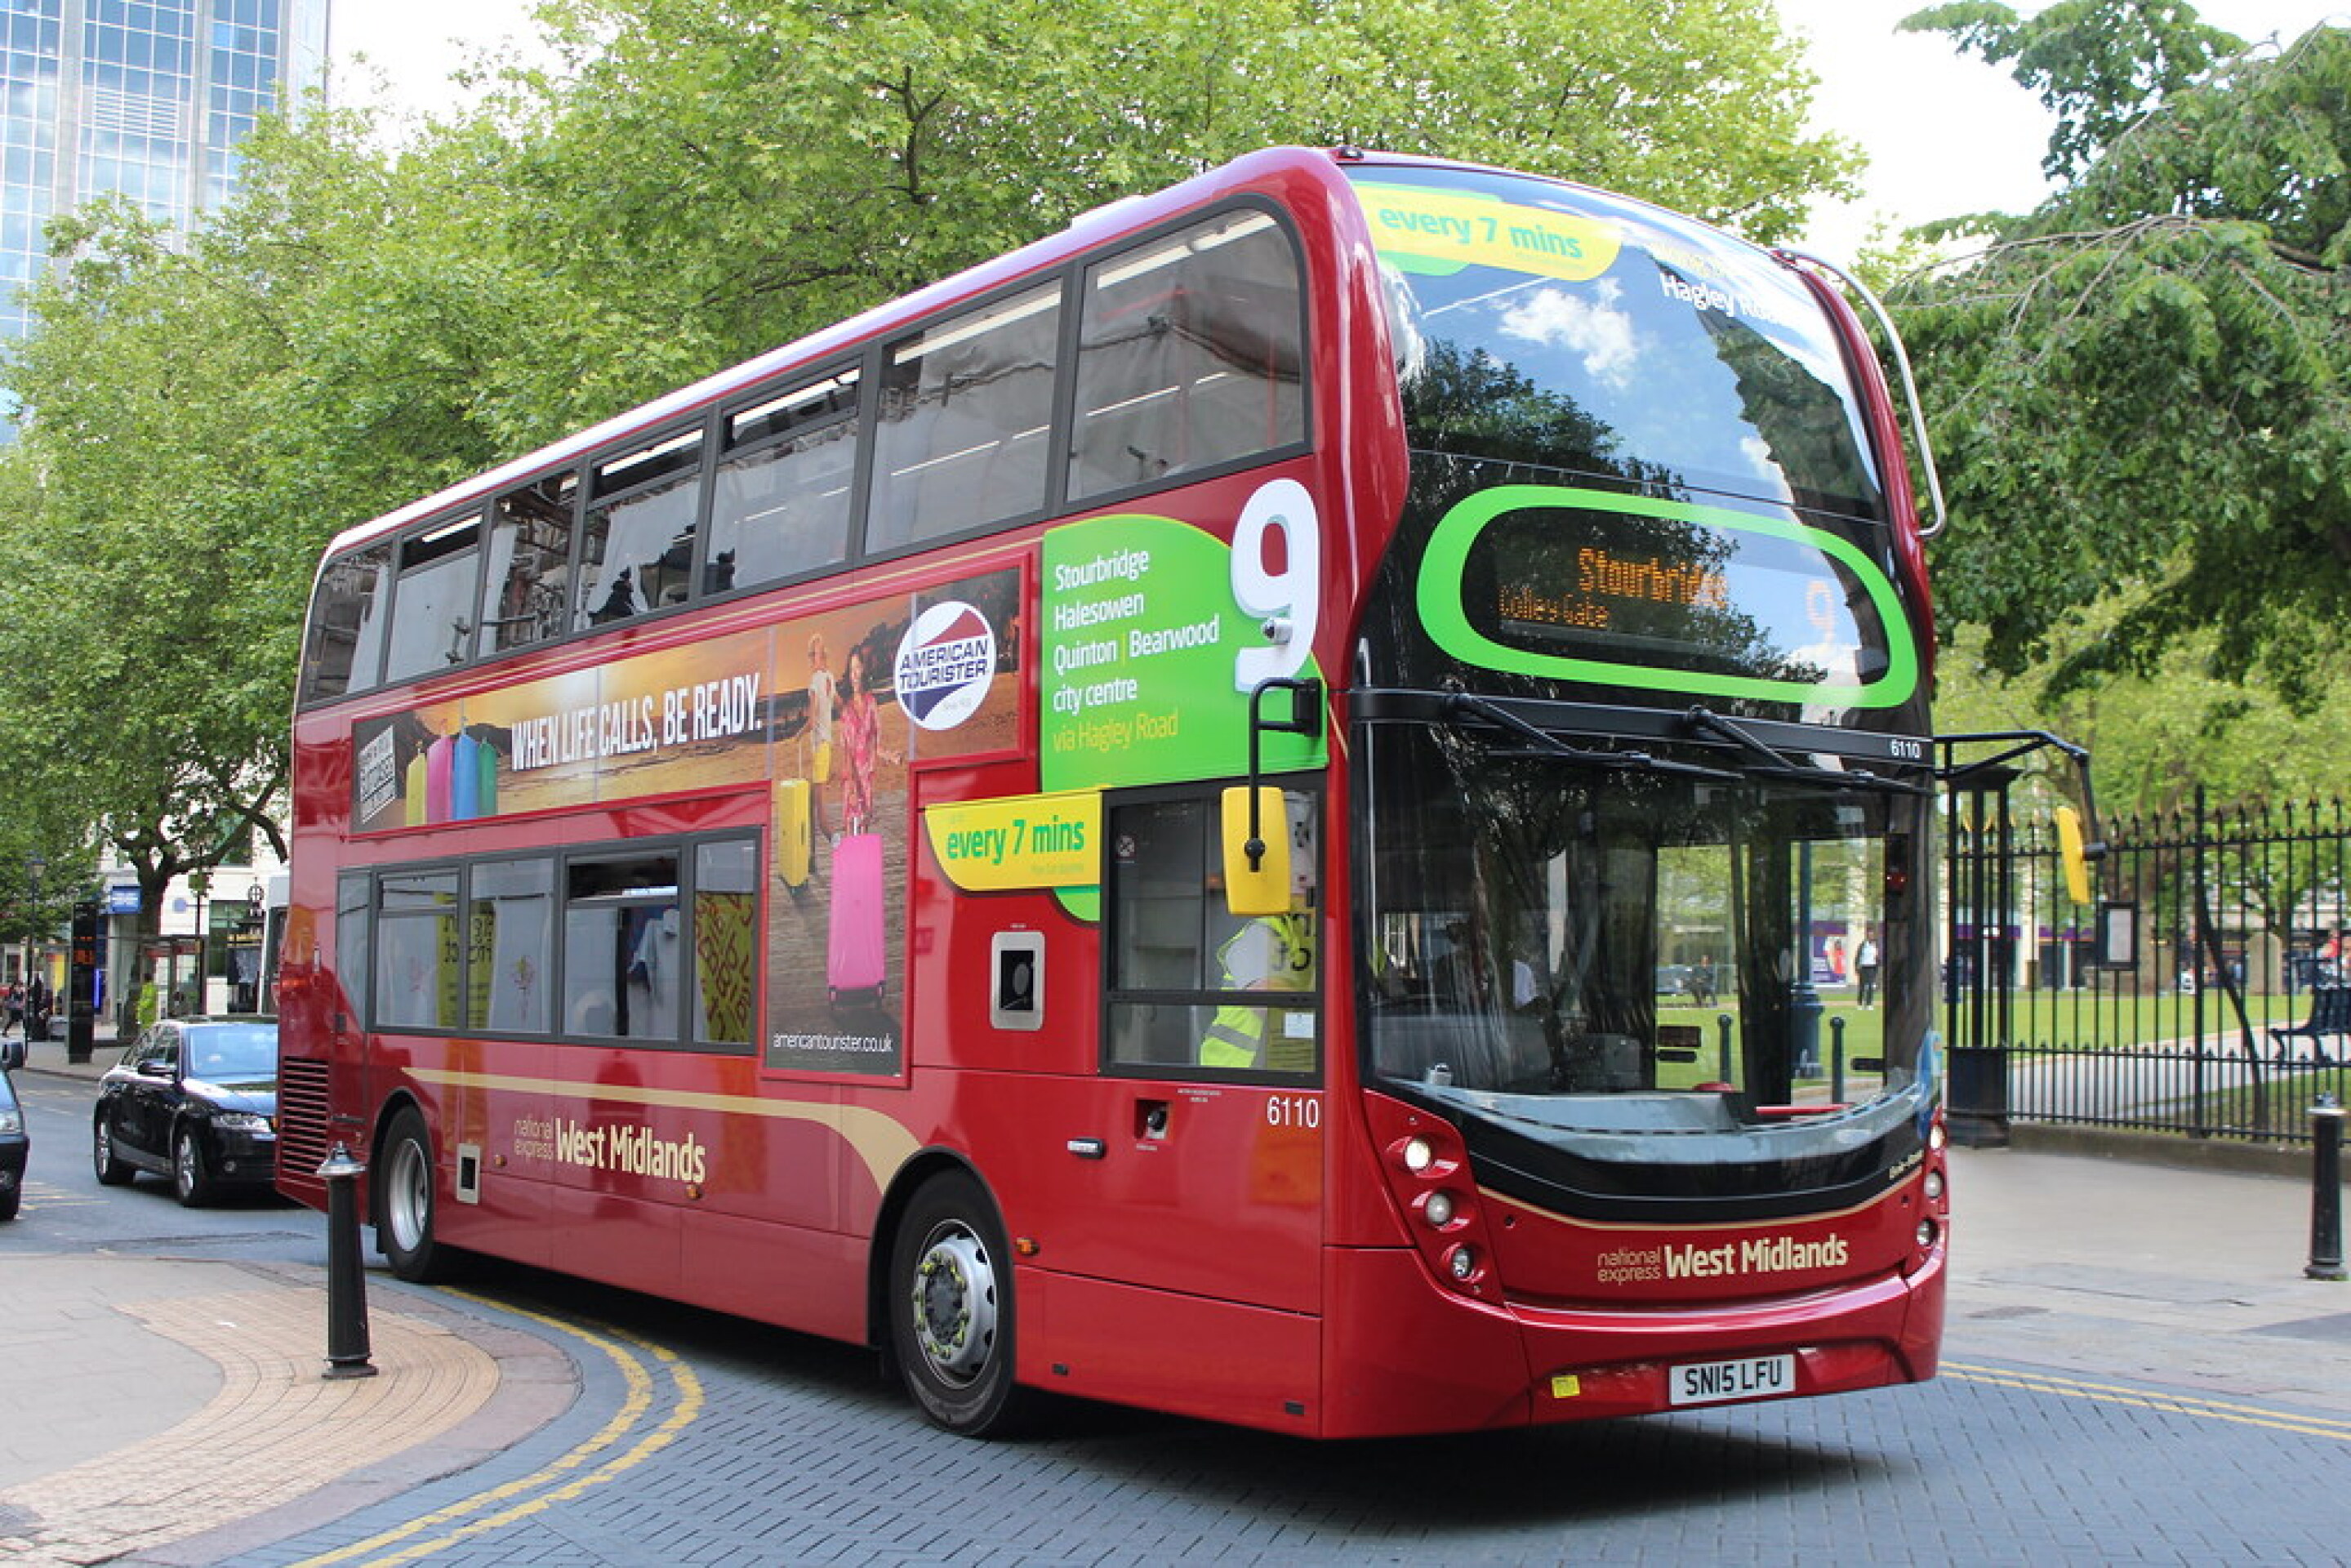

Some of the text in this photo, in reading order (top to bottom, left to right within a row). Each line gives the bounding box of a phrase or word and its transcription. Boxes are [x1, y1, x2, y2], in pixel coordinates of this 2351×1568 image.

[1378, 207, 1583, 259] every 7 mins
[1659, 272, 1734, 318] Hagley
[1055, 546, 1150, 591] Stourbridge
[1231, 477, 1320, 693] 9
[1054, 592, 1144, 632] Halesowen
[899, 637, 988, 671] AMERICAN
[1053, 612, 1221, 676] Quinton Bearwood
[899, 658, 988, 691] TOURISTER
[1053, 676, 1138, 717] city centre
[511, 672, 764, 772] WHEN LIFE CALLS, BE READY.
[1053, 706, 1179, 754] via Hagley Road
[1890, 738, 1921, 759] 6110
[947, 814, 1085, 866] every 7 mins
[514, 1114, 554, 1140] national
[1267, 1094, 1320, 1129] 6110
[514, 1138, 554, 1160] express
[554, 1117, 706, 1184] West Midlands
[1597, 1245, 1661, 1267] national
[1597, 1265, 1661, 1286] express
[1663, 1232, 1850, 1280] West Midlands
[1684, 1358, 1783, 1396] SN15 LFU
